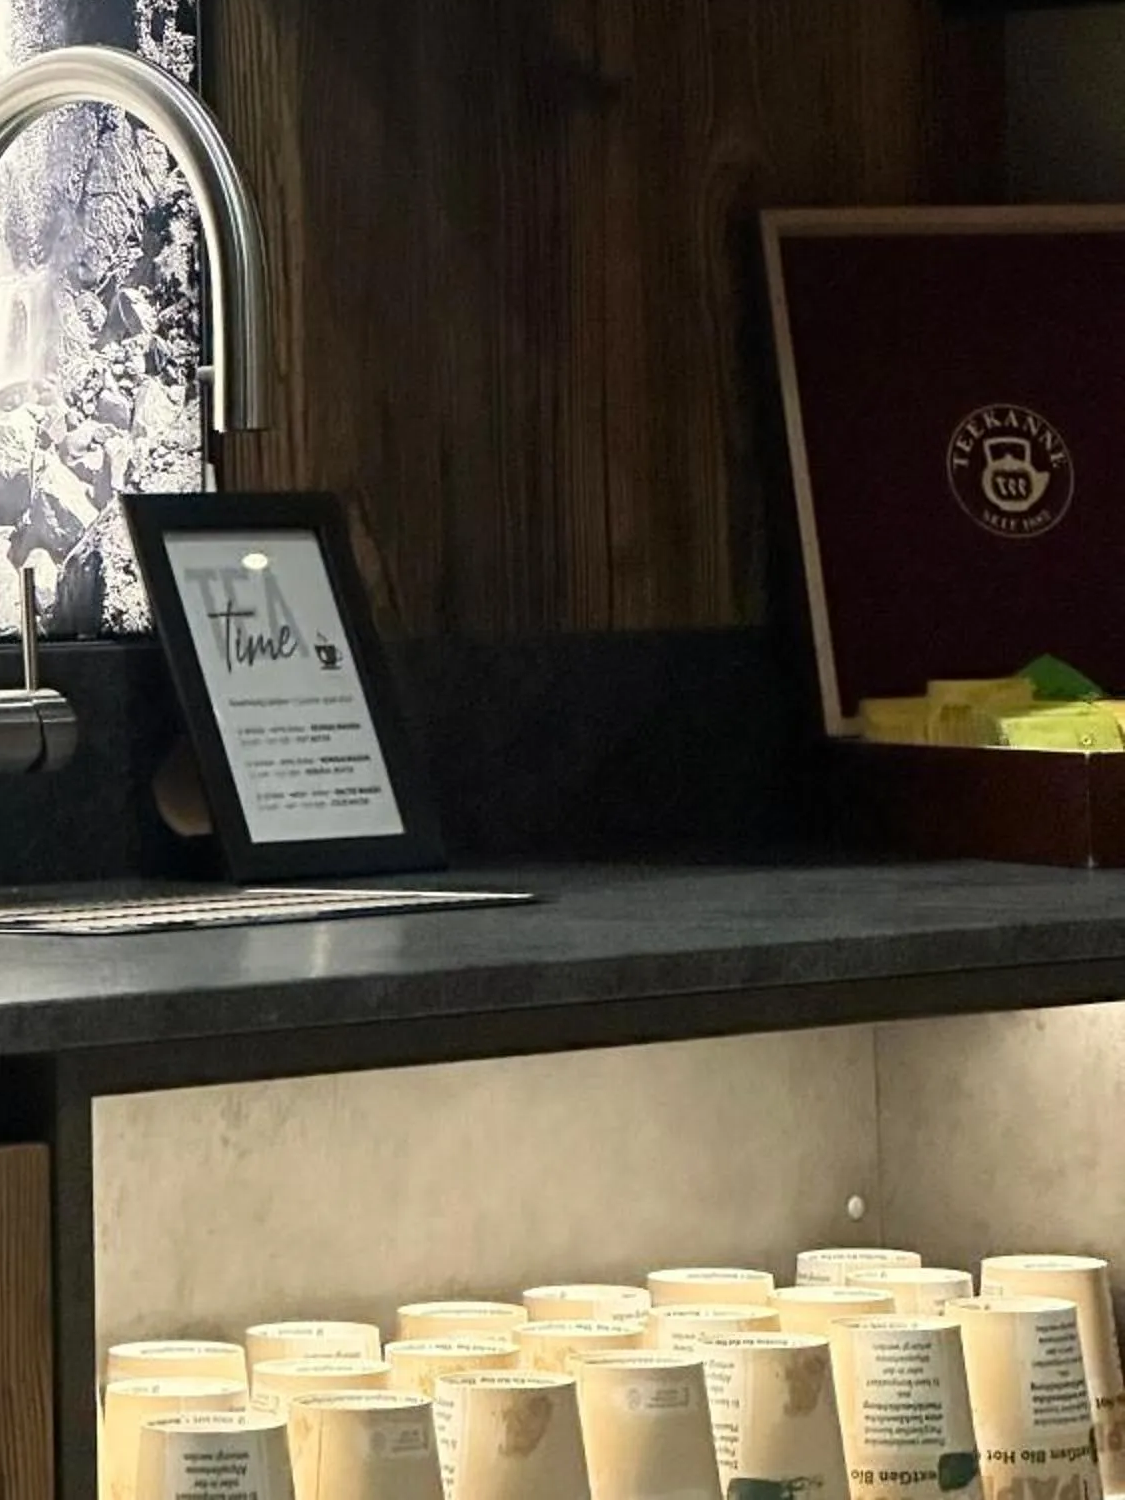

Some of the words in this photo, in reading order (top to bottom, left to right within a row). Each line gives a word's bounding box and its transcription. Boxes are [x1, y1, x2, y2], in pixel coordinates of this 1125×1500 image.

[952, 409, 1068, 469] TEEKANNE
[184, 567, 311, 660] TEA
[987, 1450, 1016, 1465] Hot
[850, 1470, 874, 1485] Bio
